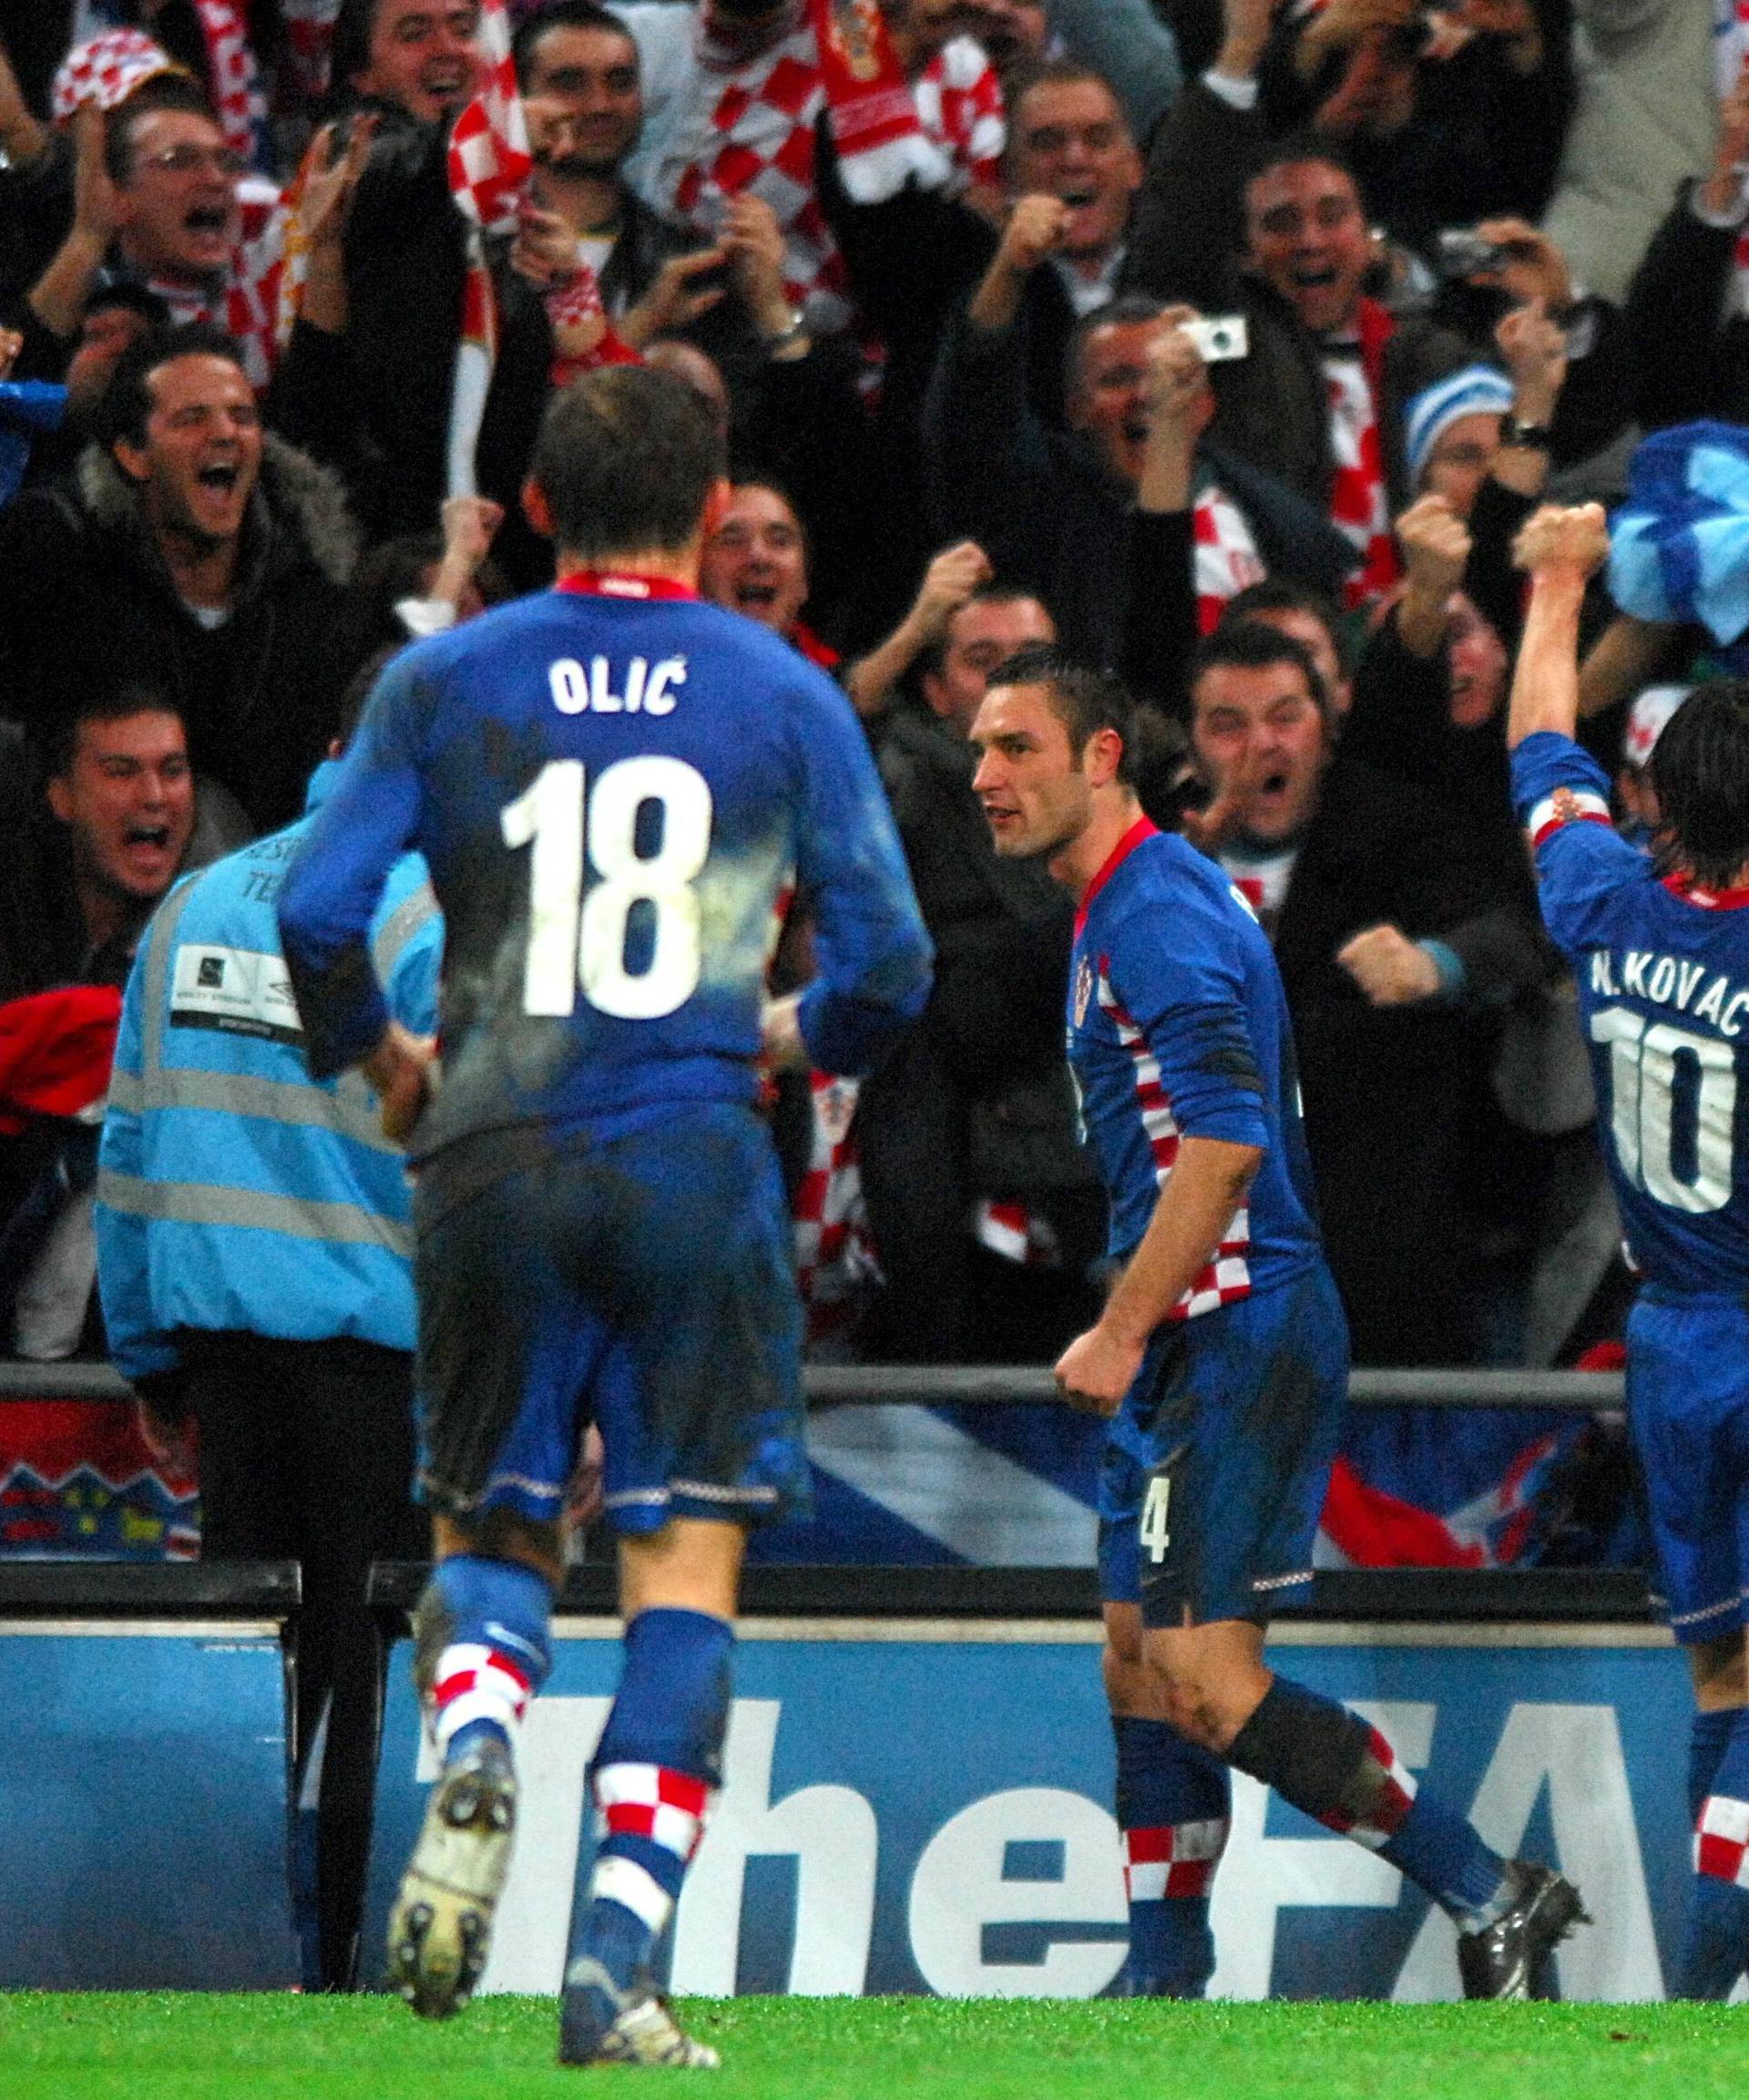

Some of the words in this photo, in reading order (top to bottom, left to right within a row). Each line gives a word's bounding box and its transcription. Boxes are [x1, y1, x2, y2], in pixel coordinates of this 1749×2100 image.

[501, 754, 713, 1019] 18
[1590, 1007, 1737, 1214] 10
[1140, 1478, 1171, 1563] 4
[415, 1696, 1130, 2001] The
[1204, 1700, 1666, 2003] FA
